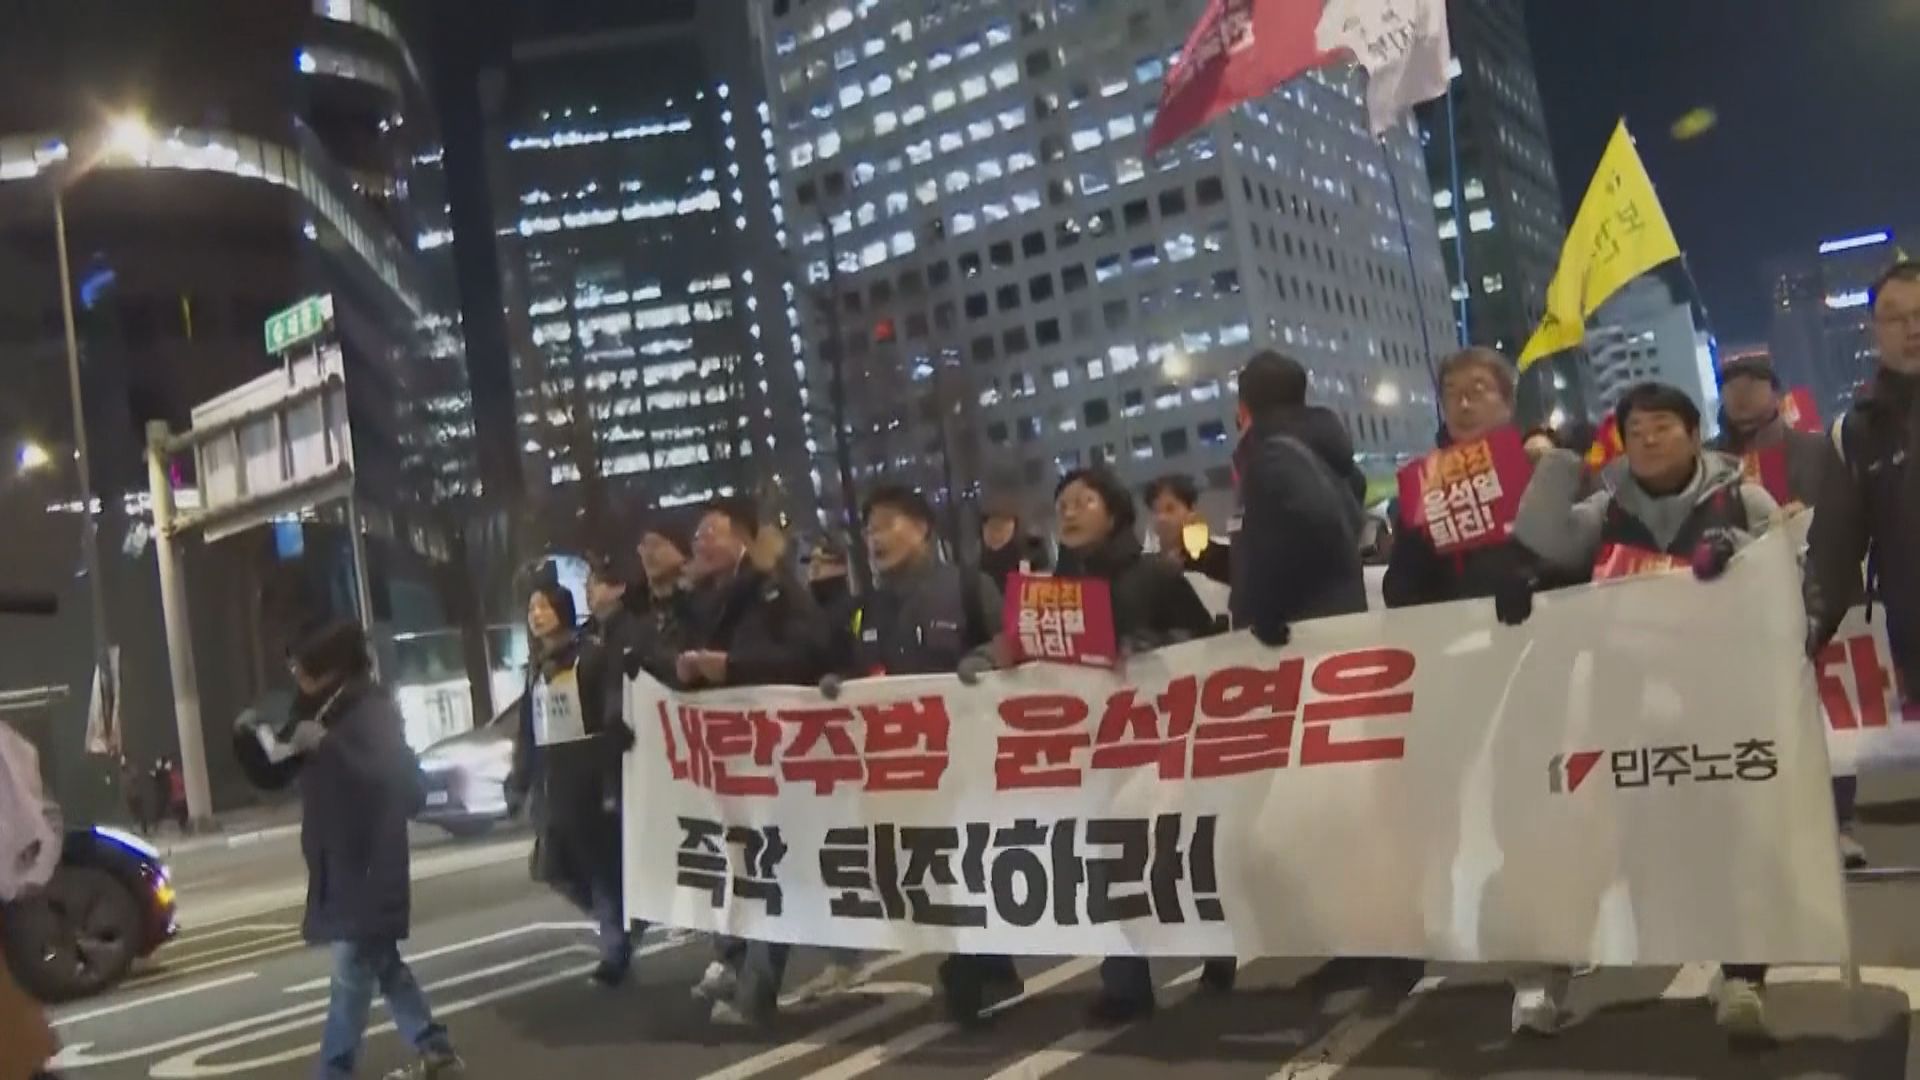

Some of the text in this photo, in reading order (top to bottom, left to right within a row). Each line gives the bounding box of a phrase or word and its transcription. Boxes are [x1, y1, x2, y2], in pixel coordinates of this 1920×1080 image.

[1423, 470, 1503, 523] 윤석열
[1429, 502, 1496, 548] 퇴진!
[1018, 608, 1085, 636] 윤석열
[1020, 632, 1076, 657] 퇴진!
[658, 647, 1416, 796] 내란주범 윤석열은
[1611, 738, 1778, 788] 민주노총
[676, 813, 1225, 929] 즉각 퇴진하라!
